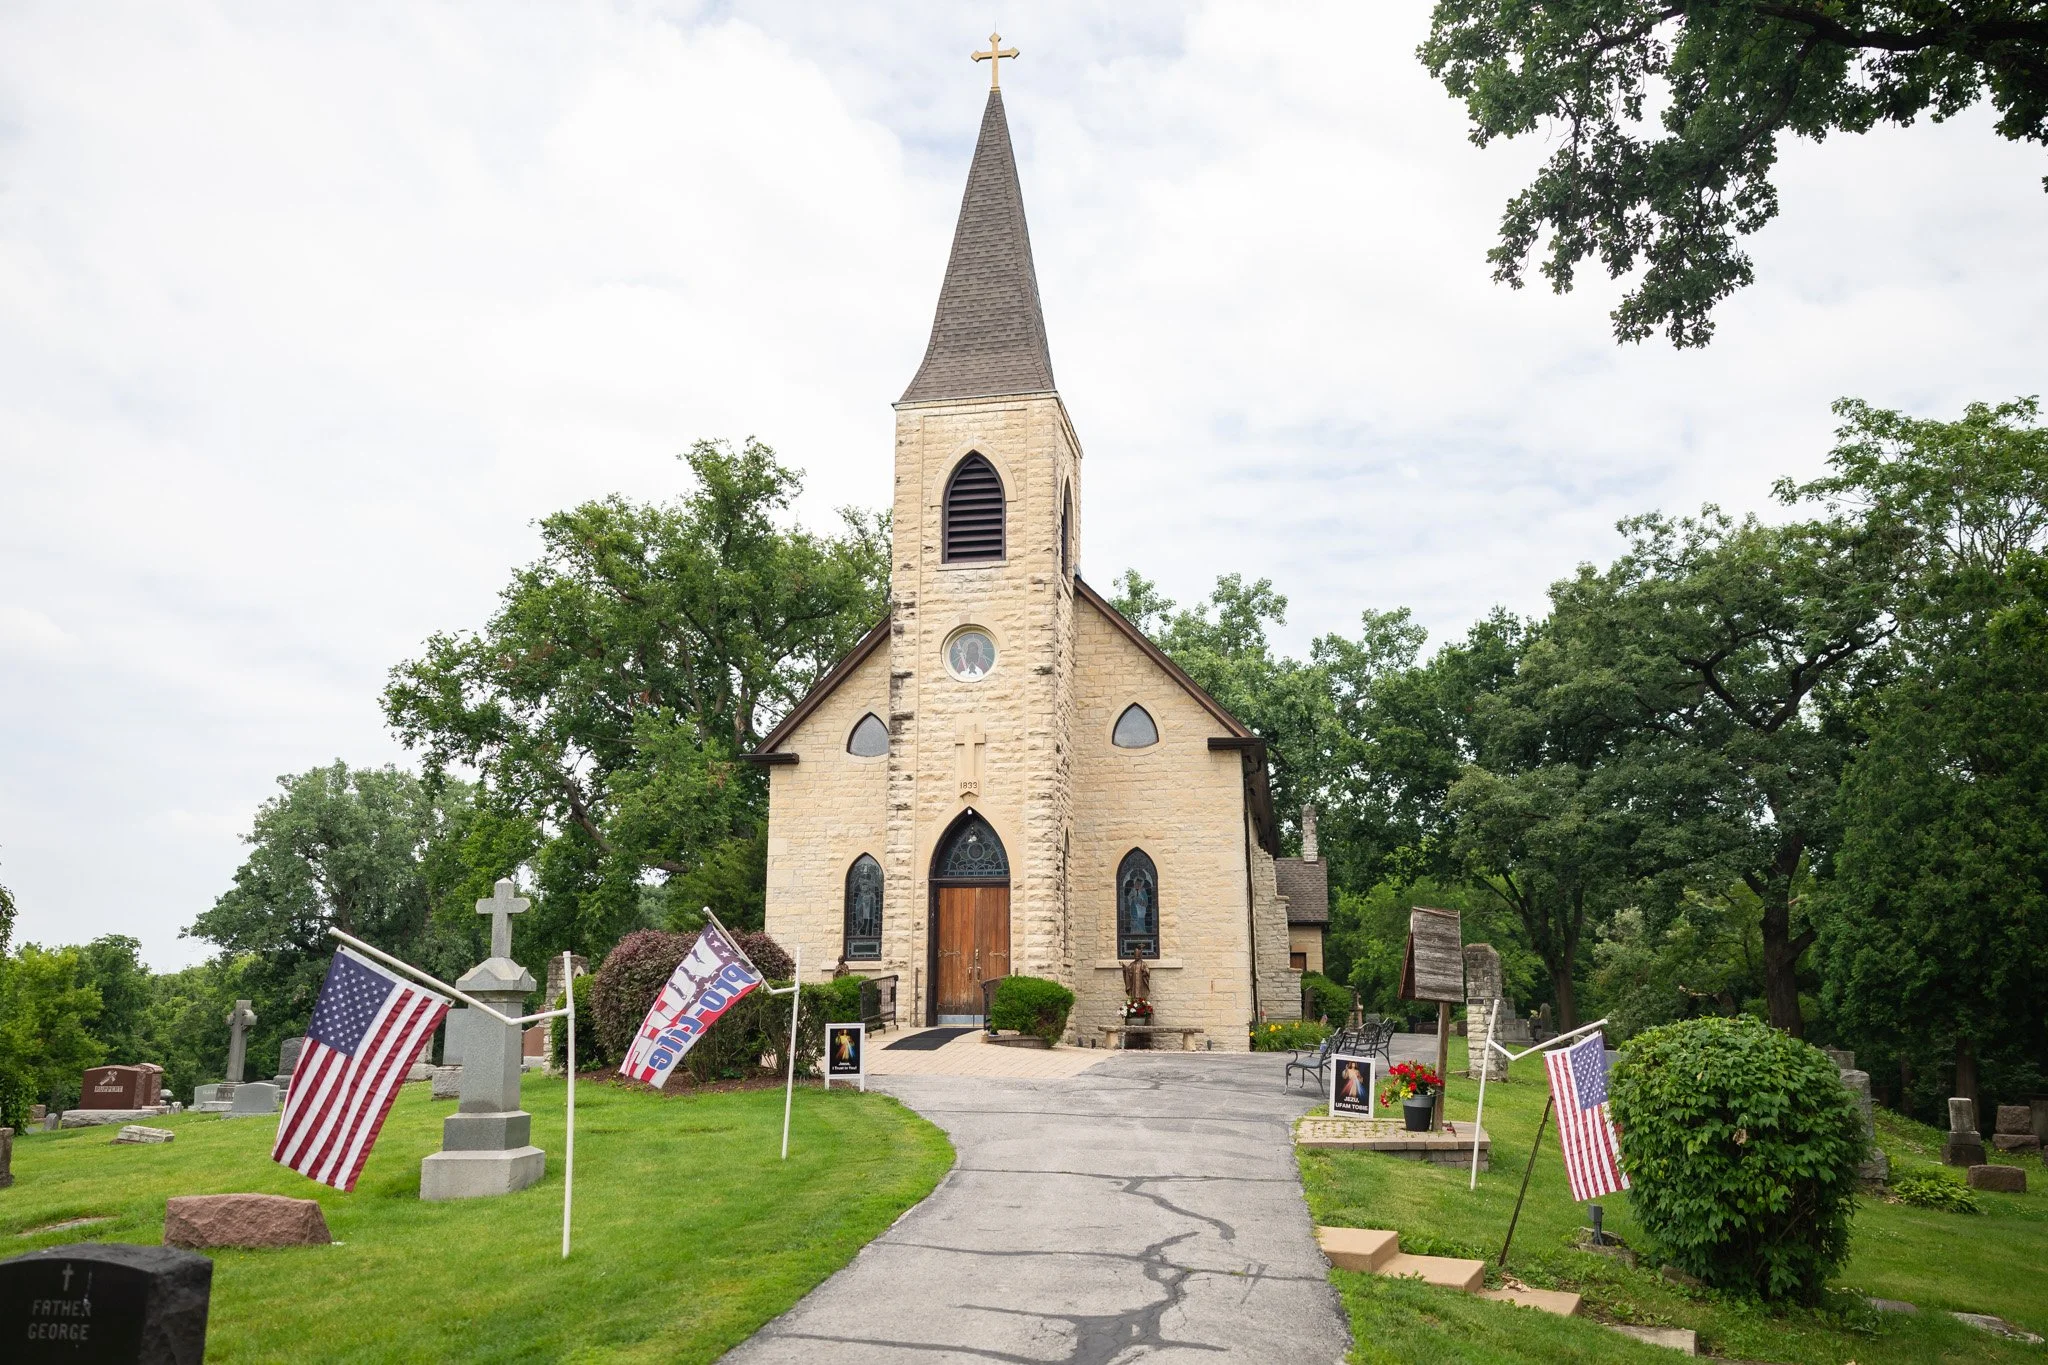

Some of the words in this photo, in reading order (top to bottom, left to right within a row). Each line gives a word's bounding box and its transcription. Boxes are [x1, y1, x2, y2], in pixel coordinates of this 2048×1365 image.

[960, 781, 978, 789] 1833
[32, 1299, 92, 1316] FATHER
[28, 1323, 90, 1340] GEORGE
